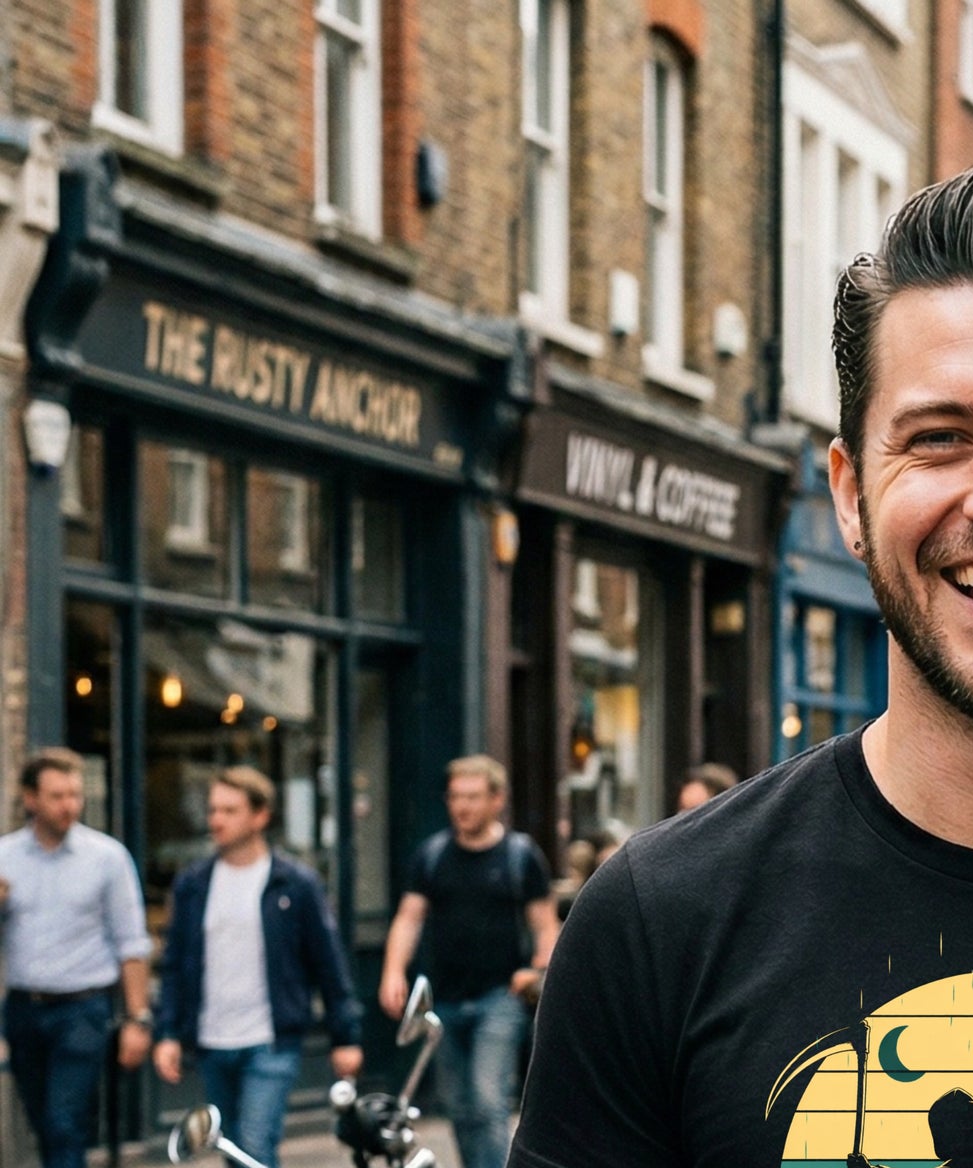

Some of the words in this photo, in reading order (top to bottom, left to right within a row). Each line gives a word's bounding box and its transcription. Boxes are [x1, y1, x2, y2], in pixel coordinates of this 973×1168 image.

[143, 300, 207, 386] THE
[211, 324, 311, 412] RUSTY
[309, 363, 422, 447] ANCHOR
[566, 431, 634, 511] VINYL
[635, 455, 658, 516] &
[656, 463, 740, 540] COFFEE
